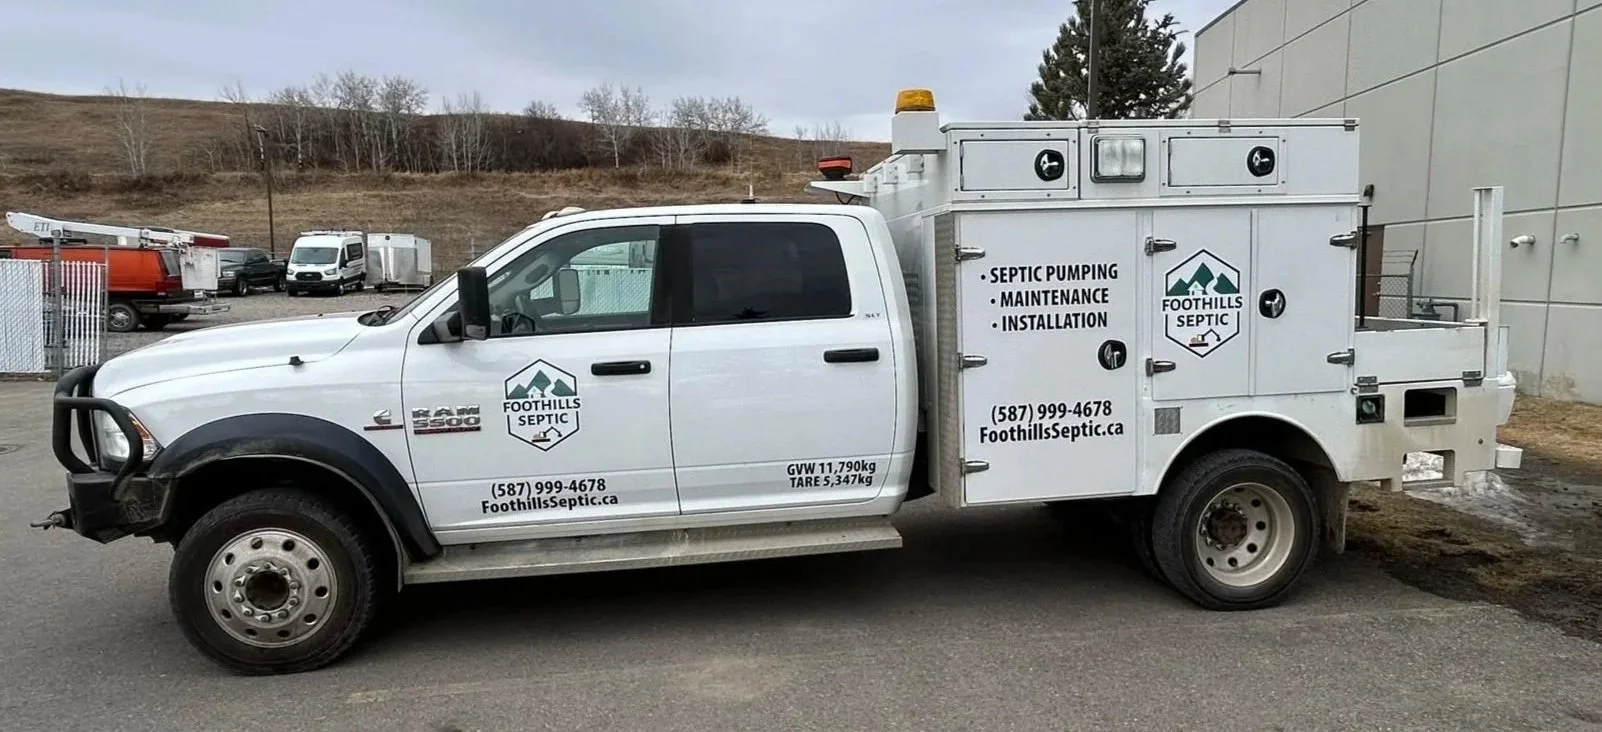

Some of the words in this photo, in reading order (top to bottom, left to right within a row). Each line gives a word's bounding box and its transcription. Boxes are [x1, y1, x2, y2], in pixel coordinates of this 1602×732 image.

[33, 221, 50, 232] ETI
[990, 264, 1043, 284] SEPTIC
[1045, 263, 1119, 282] PUMPING
[1000, 287, 1110, 308] MAINTENANCE
[1161, 296, 1243, 312] FOOTHILLS
[1001, 311, 1109, 332] INSTALLATION
[1176, 312, 1230, 328] SEPTIC
[411, 404, 480, 418] RAM
[503, 398, 581, 413] FOOTHILLS
[990, 404, 1035, 426] (587)
[1037, 400, 1113, 420] 999-4678
[412, 415, 481, 428] 5500
[517, 412, 569, 426] SEPTIC
[979, 420, 1125, 443] FoothillsSeptic.ca
[787, 463, 816, 475] GVW
[819, 460, 876, 474] 11,790kg
[491, 482, 532, 499] (587)
[535, 478, 606, 494] 999-4678
[790, 476, 820, 488] TARE
[823, 473, 873, 487] 5,347kg
[481, 494, 618, 513] FoothillsSeptic.ca
